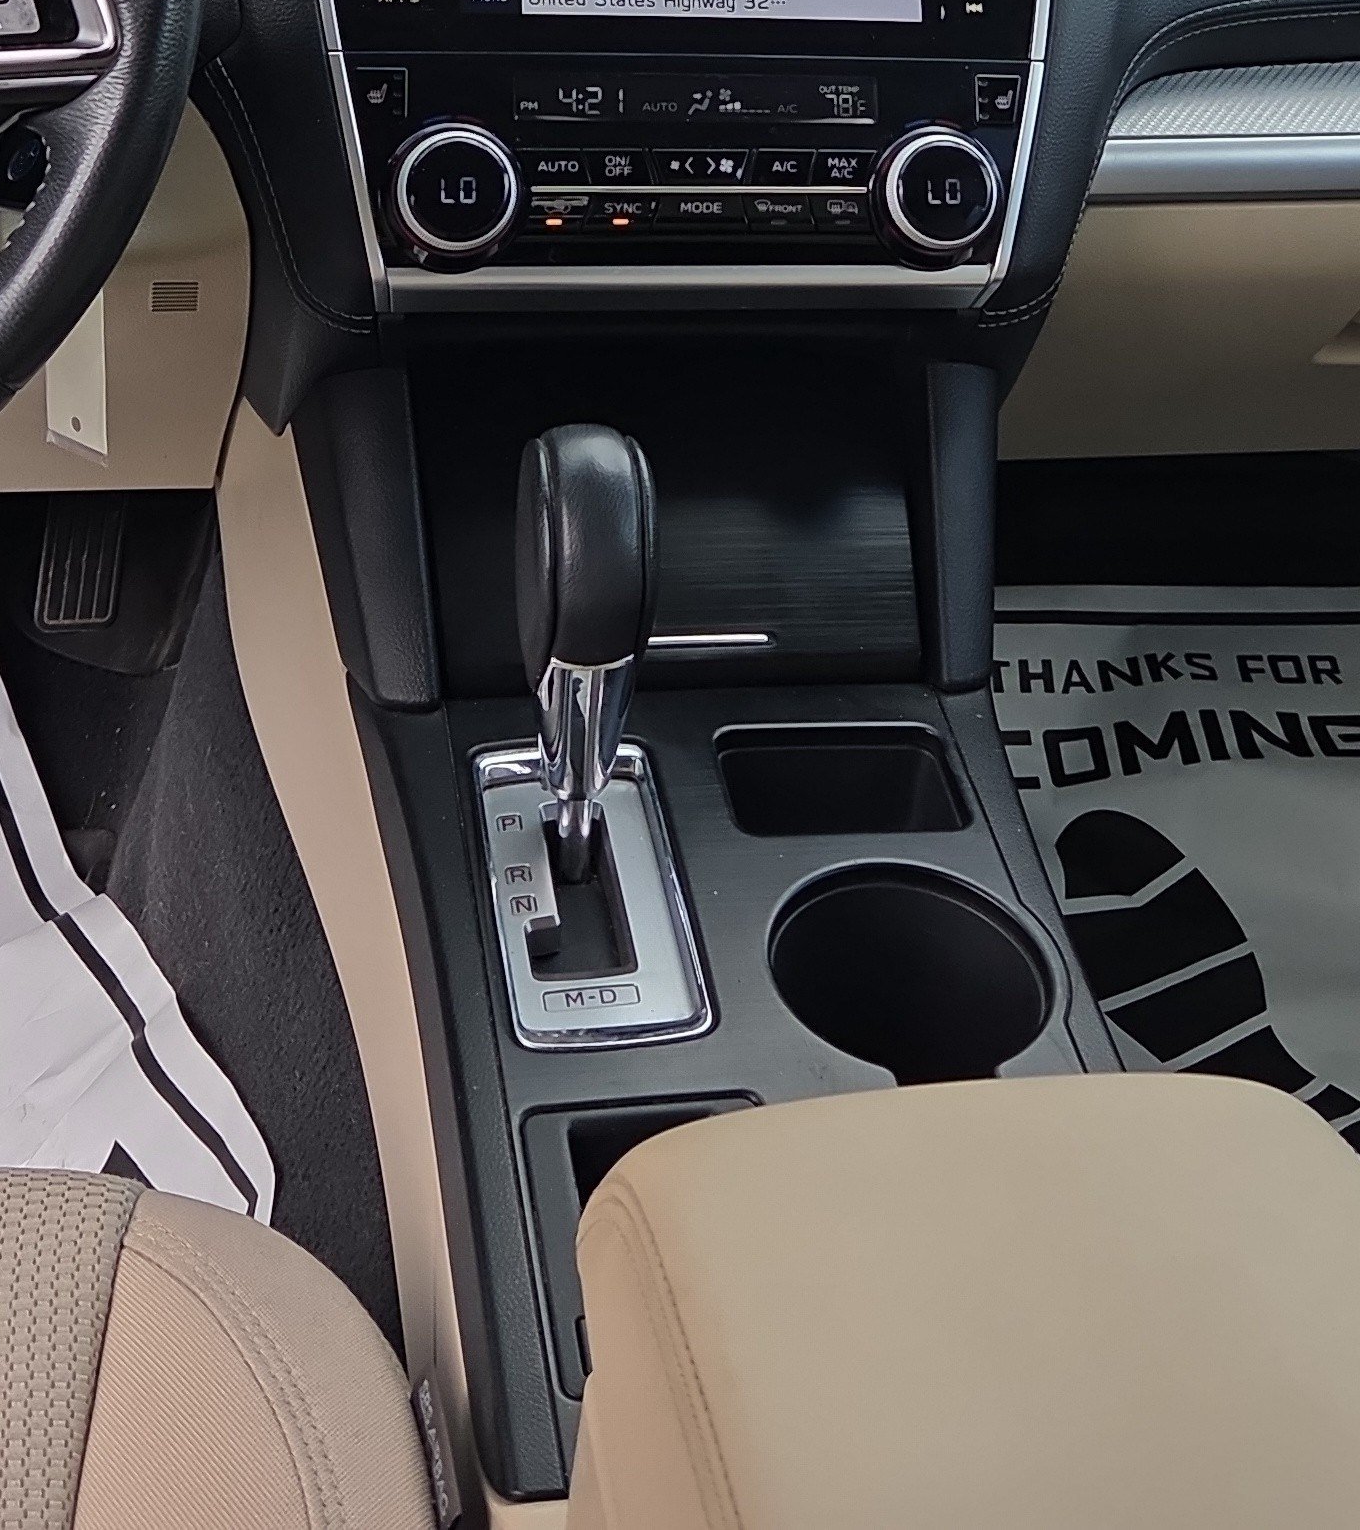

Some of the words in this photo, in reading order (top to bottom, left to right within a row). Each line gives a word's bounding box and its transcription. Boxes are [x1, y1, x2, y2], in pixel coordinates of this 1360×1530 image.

[819, 86, 837, 94] OUT
[838, 86, 860, 94] TEMP
[520, 101, 539, 111] PM
[559, 86, 624, 115] 4:21
[642, 102, 678, 112] AUTO
[777, 104, 798, 114] A/C
[538, 160, 579, 173] AUTO
[772, 160, 798, 173] A/C
[827, 157, 858, 168] MAX
[605, 166, 633, 177] OFF
[830, 168, 854, 179] A/C
[604, 202, 642, 214] SYNC
[680, 202, 723, 214] MODE
[769, 203, 803, 214] FRONT
[992, 652, 1218, 695] THANKS
[1236, 653, 1343, 686] FOR
[502, 817, 516, 831] P
[510, 869, 527, 883] R
[515, 899, 532, 914] N
[565, 988, 617, 1008] M-D
